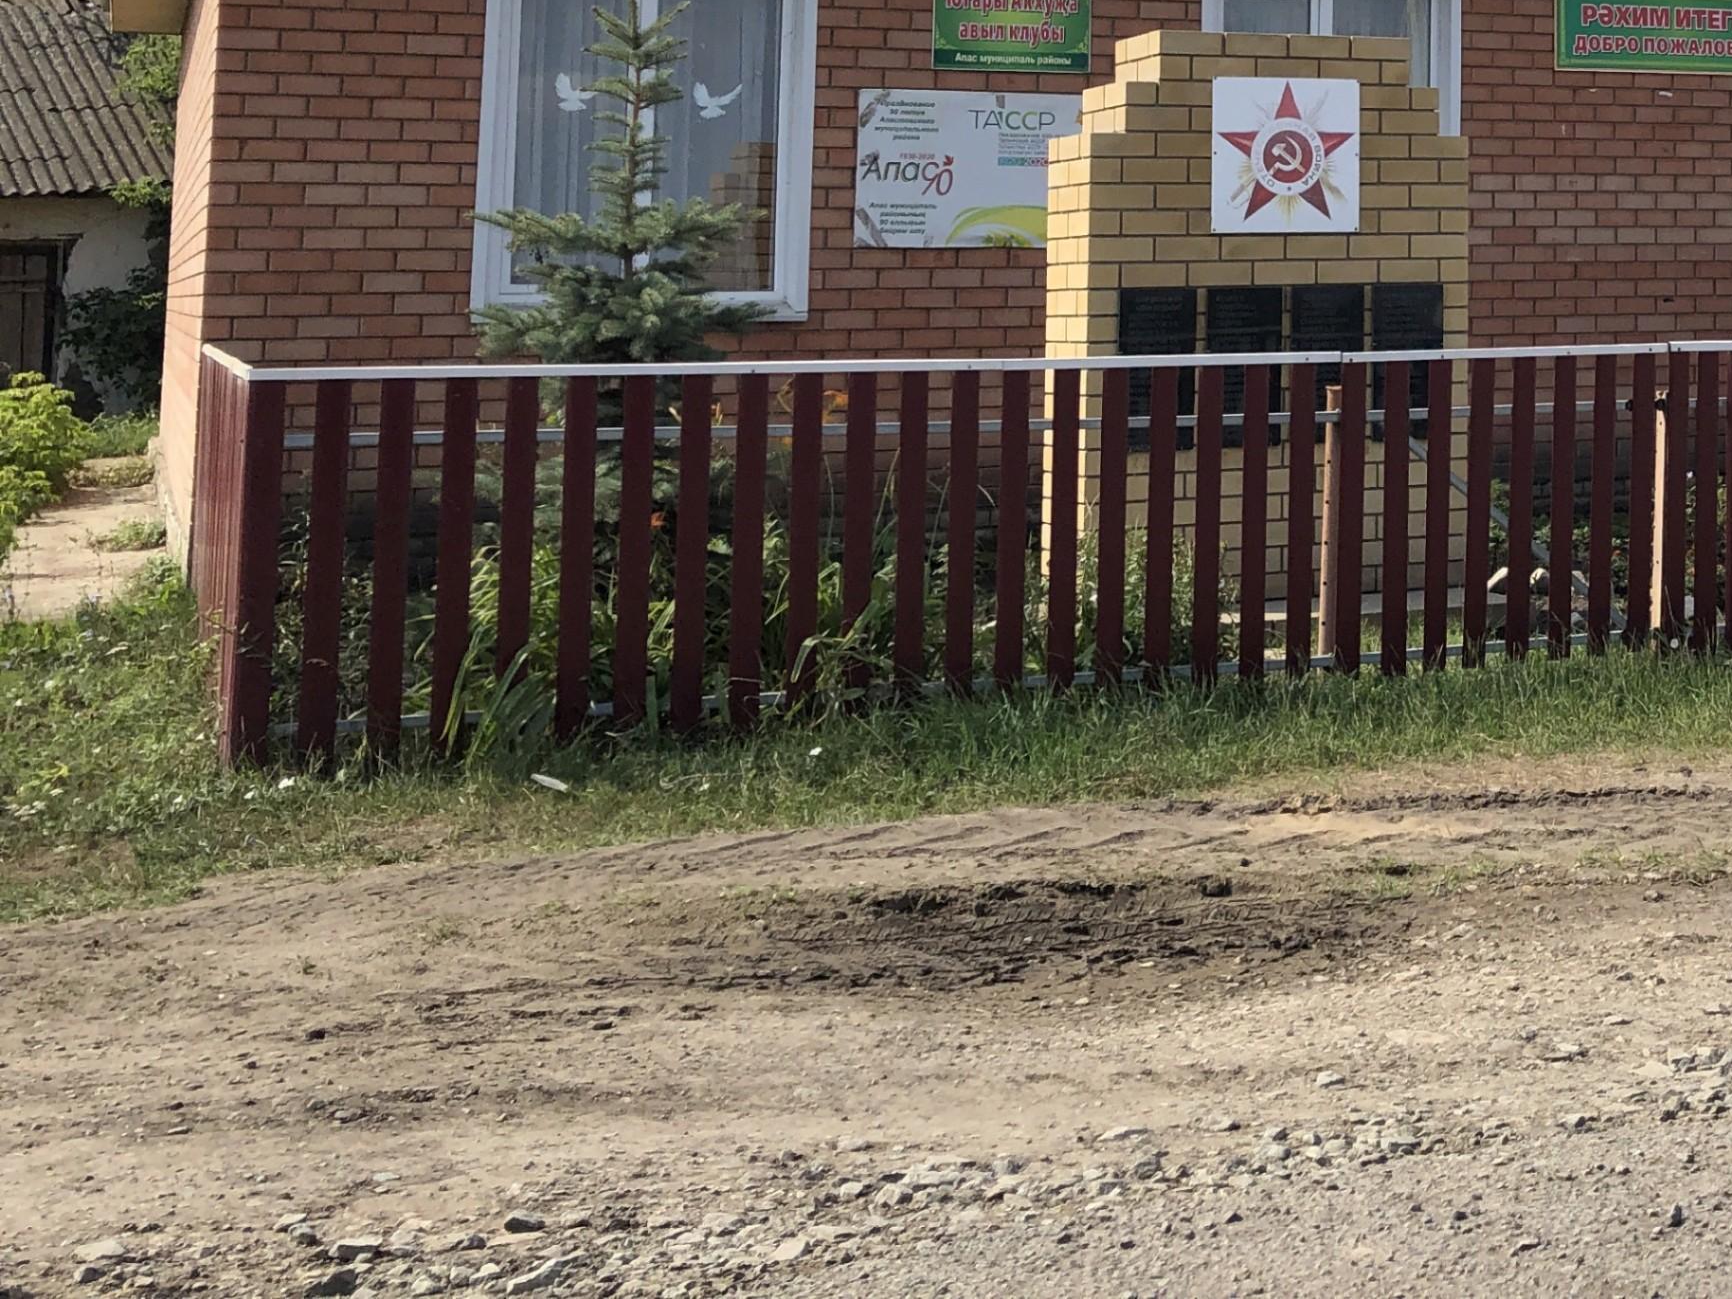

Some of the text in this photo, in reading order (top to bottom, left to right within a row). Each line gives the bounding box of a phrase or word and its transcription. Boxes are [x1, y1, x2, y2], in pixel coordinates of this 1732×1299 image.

[1581, 3, 1670, 28] РӘХИМ
[959, 19, 1065, 49] авыл клубы
[1573, 34, 1640, 56] ДОБРО
[955, 52, 977, 63] Апас
